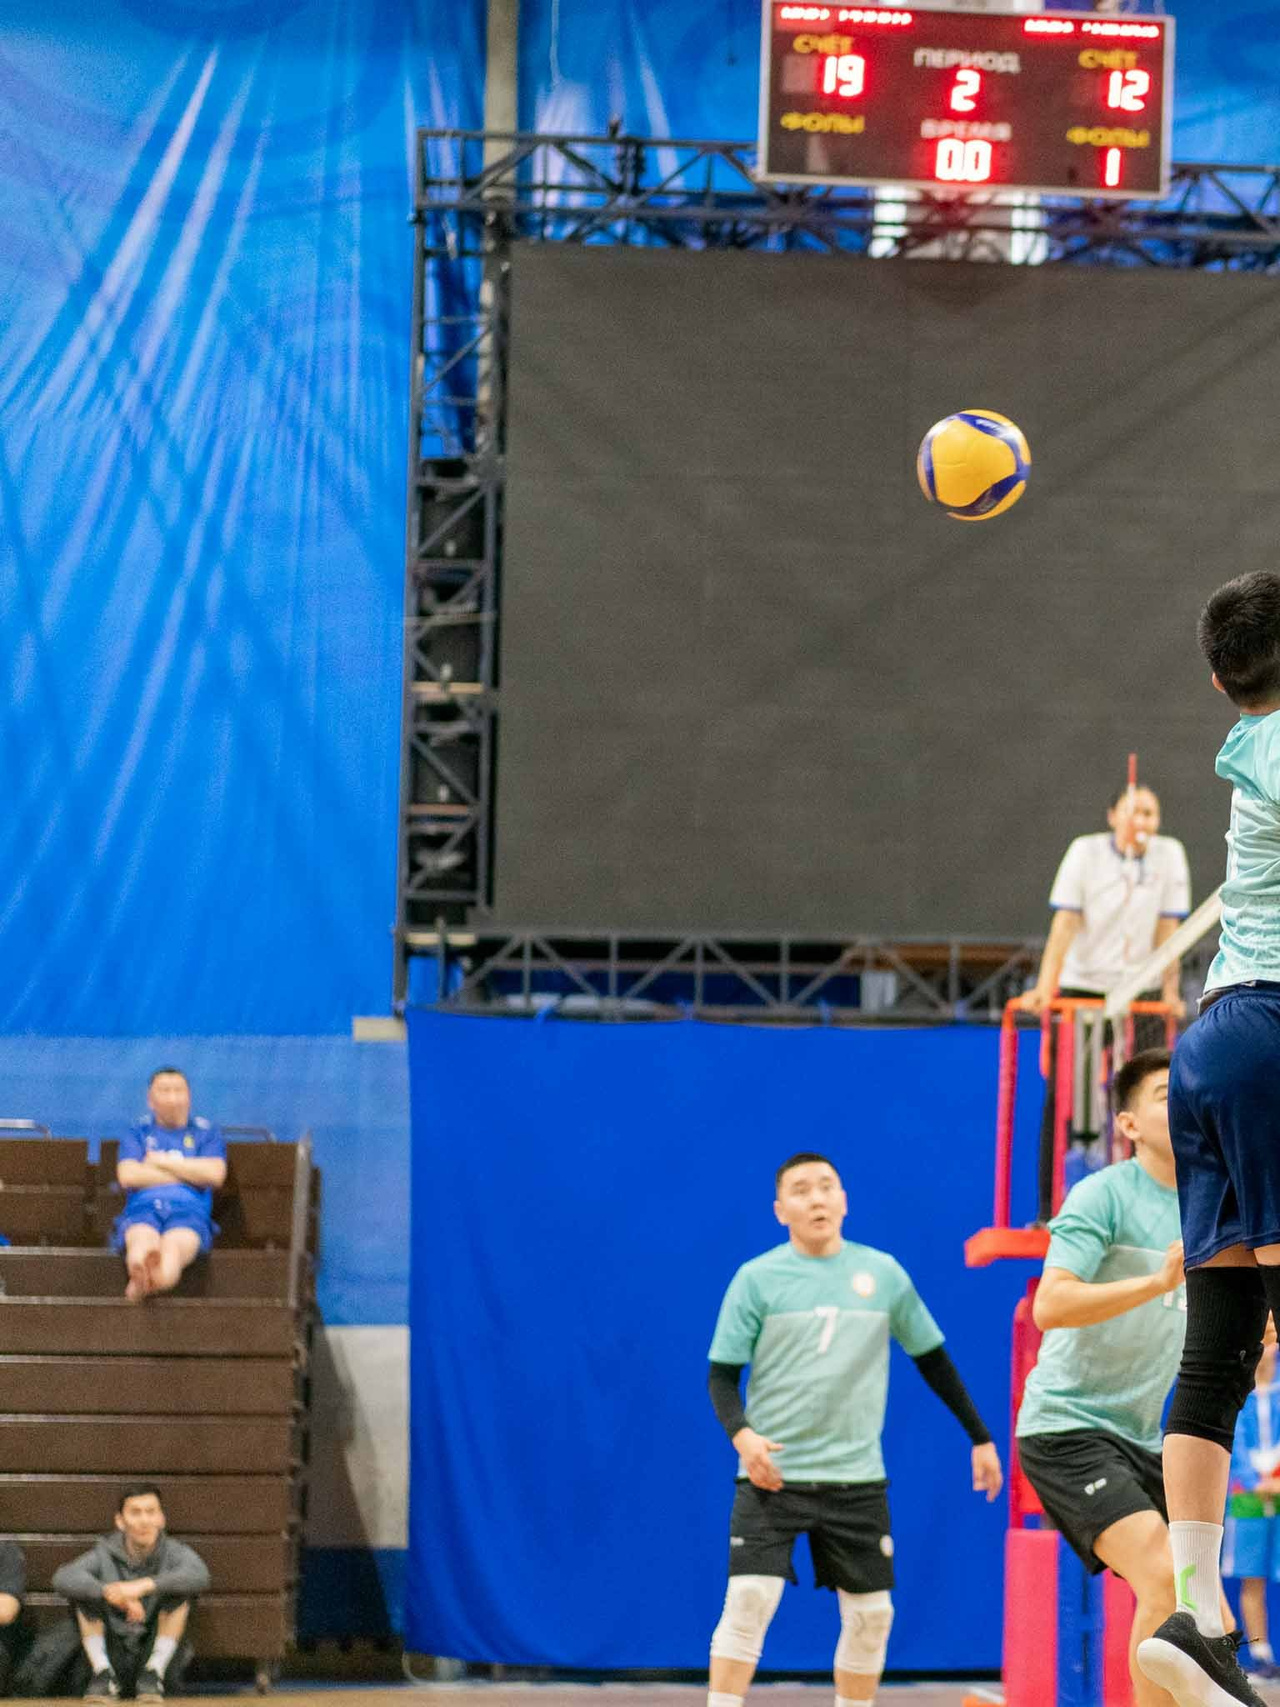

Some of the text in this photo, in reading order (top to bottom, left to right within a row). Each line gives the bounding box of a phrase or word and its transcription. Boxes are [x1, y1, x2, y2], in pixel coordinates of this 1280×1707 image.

[823, 54, 865, 97] 19
[913, 48, 1020, 75] ПЕРИОД
[950, 69, 980, 111] 2
[1108, 69, 1150, 111] 12
[935, 138, 992, 182] 00
[1105, 148, 1120, 186] 1
[814, 1306, 839, 1354] 7
